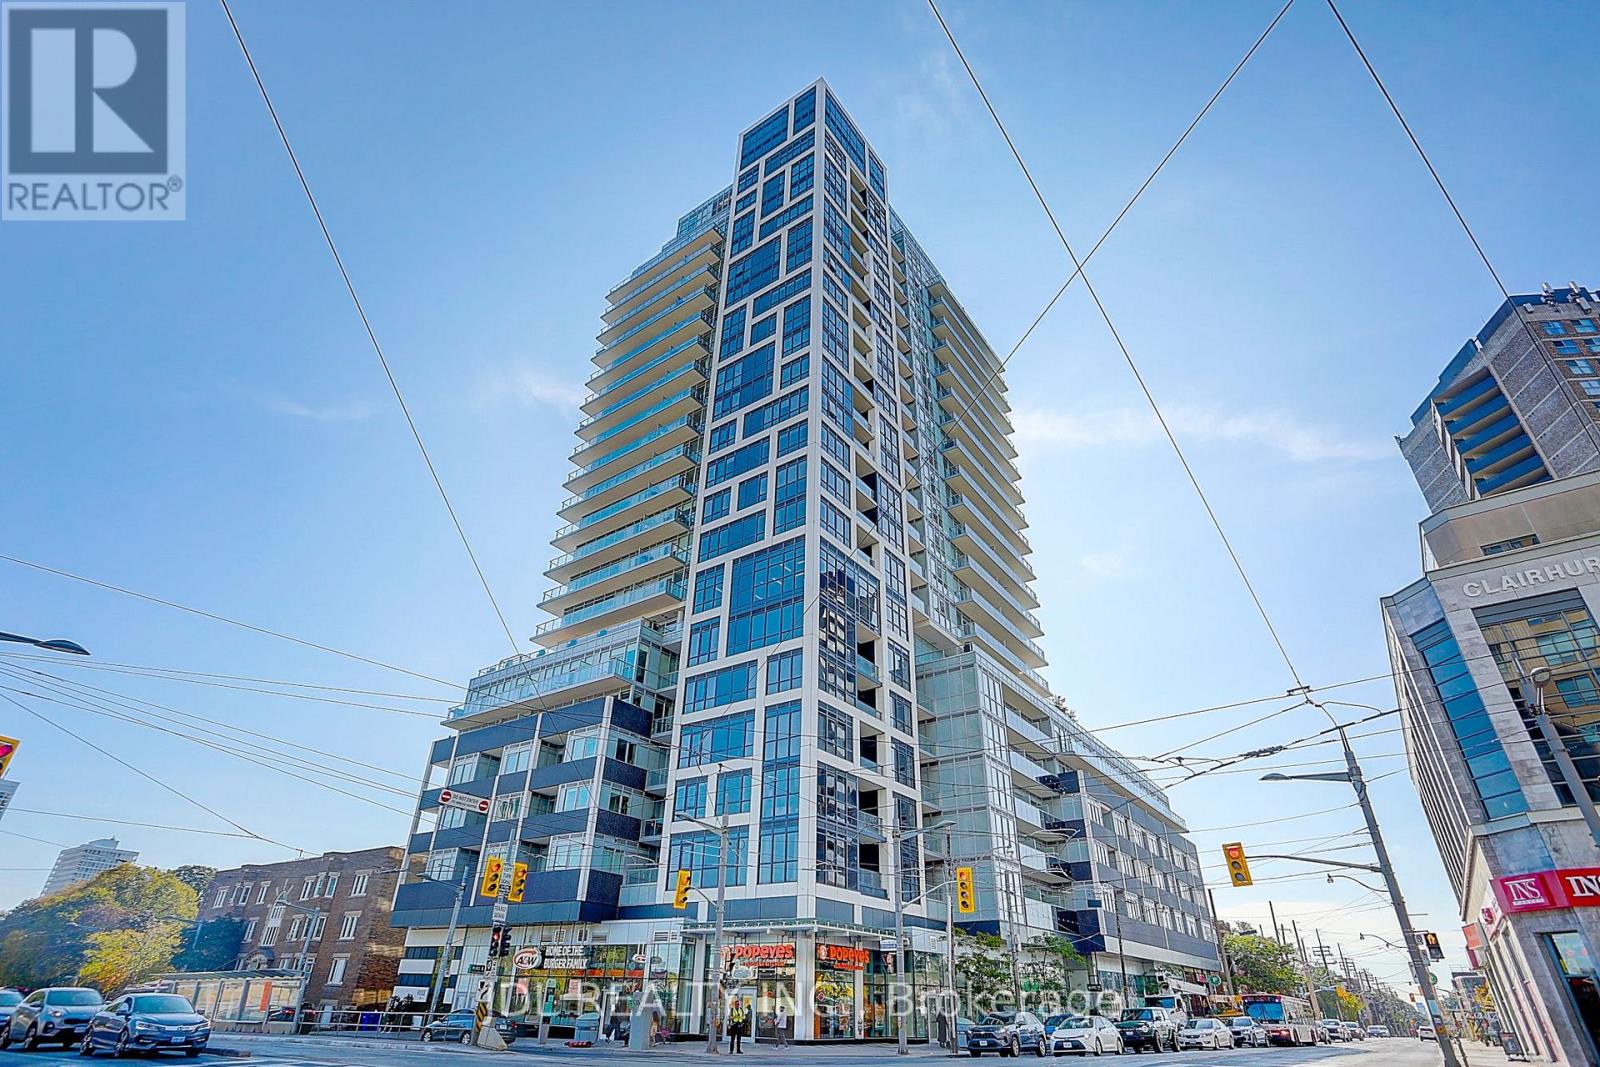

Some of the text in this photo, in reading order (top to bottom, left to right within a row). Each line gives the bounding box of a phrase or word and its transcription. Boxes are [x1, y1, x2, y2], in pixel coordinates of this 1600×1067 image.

[1462, 556, 1600, 597] CLAIRHUR
[1506, 880, 1542, 900] INS
[545, 946, 585, 956] HOME OF THE
[516, 955, 538, 966] A&W
[543, 958, 588, 969] BURGER FAMILY
